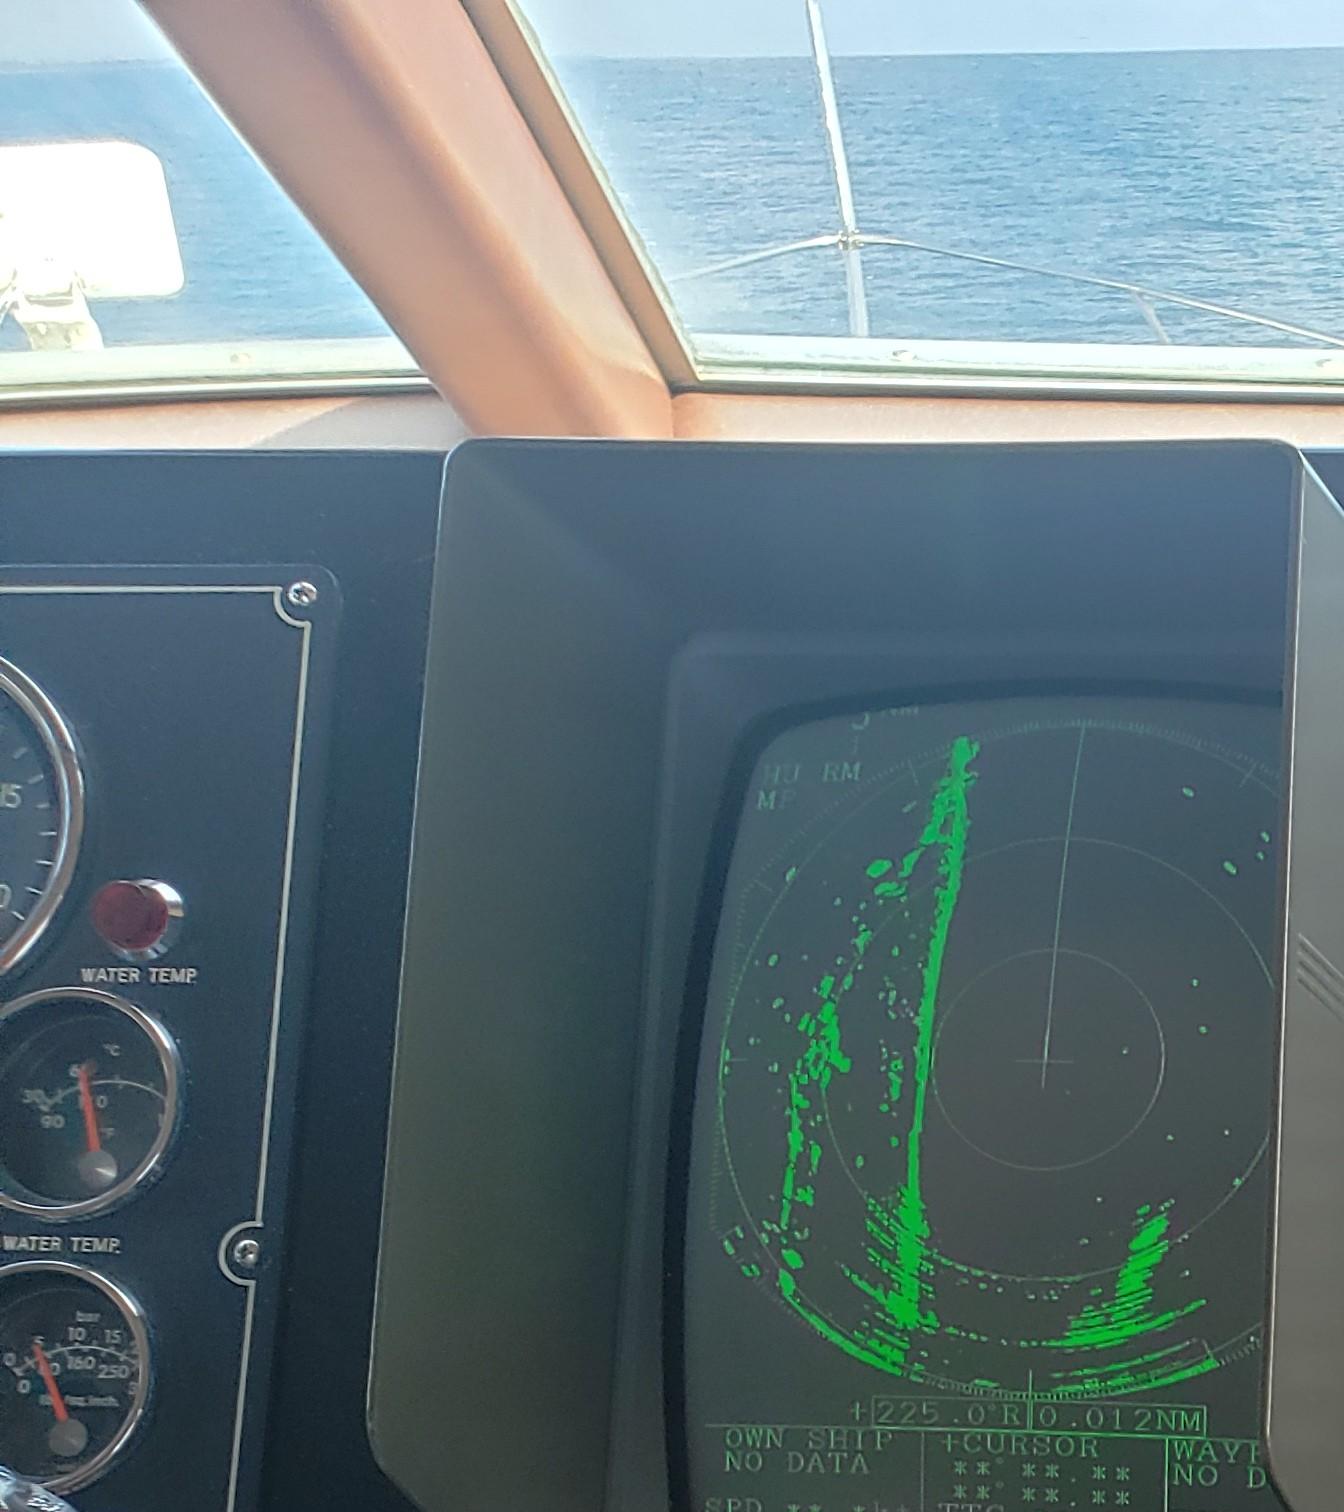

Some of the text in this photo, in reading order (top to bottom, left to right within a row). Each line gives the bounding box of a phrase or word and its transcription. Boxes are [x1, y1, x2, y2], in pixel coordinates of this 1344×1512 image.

[822, 761, 861, 782] RM
[80, 968, 139, 984] WATER
[3, 1237, 61, 1253] WATER
[68, 1327, 121, 1343] 10 15
[97, 1365, 130, 1378] 250
[725, 1427, 893, 1450] OWN SHIP
[724, 1451, 870, 1474] NO DATA
[1173, 1464, 1218, 1487] NO
